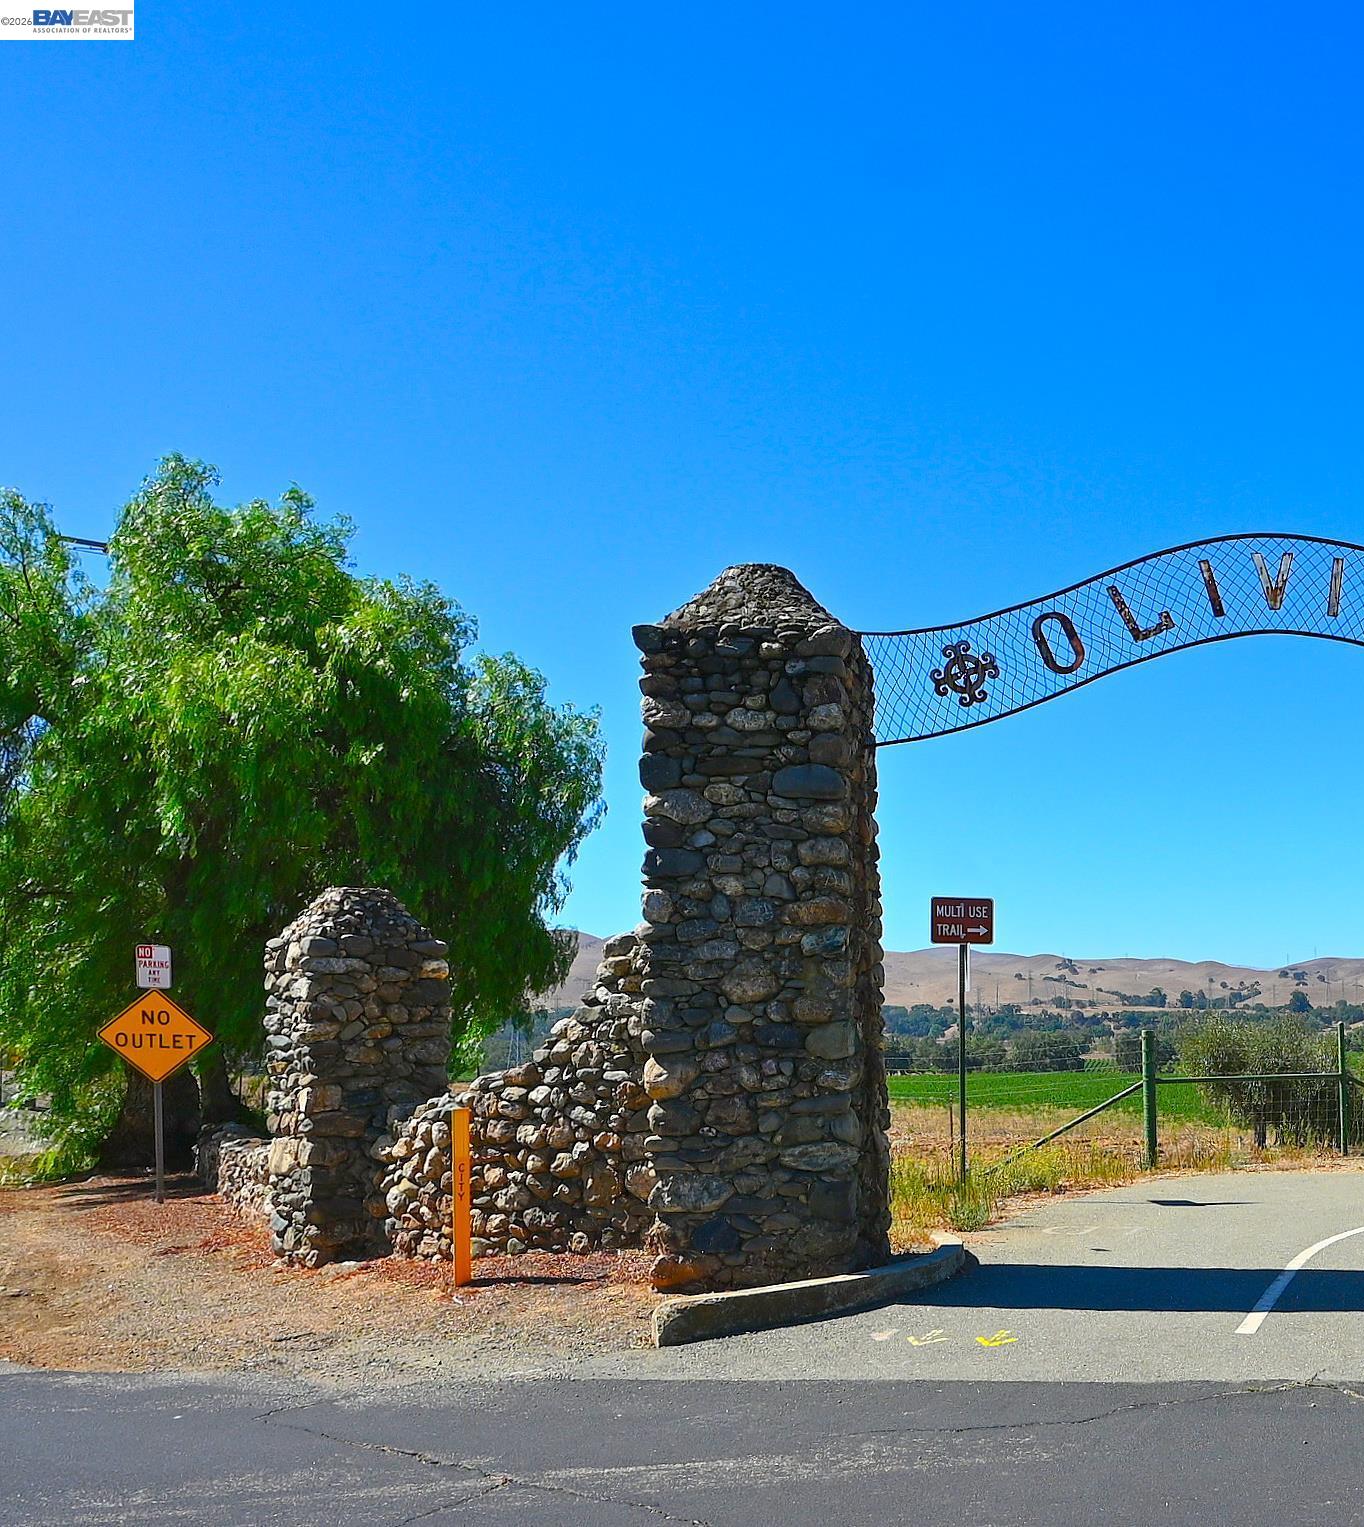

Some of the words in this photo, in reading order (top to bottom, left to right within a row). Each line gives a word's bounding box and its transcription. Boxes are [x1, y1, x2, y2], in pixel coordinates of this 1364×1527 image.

[936, 904, 964, 918] MULTI
[968, 906, 988, 918] USE
[937, 923, 966, 937] TRAIL
[138, 948, 151, 958] NO
[138, 960, 169, 969] PARKING
[141, 1010, 170, 1025] NO
[115, 1032, 196, 1049] OUTLET
[457, 1162, 465, 1201] CITY
